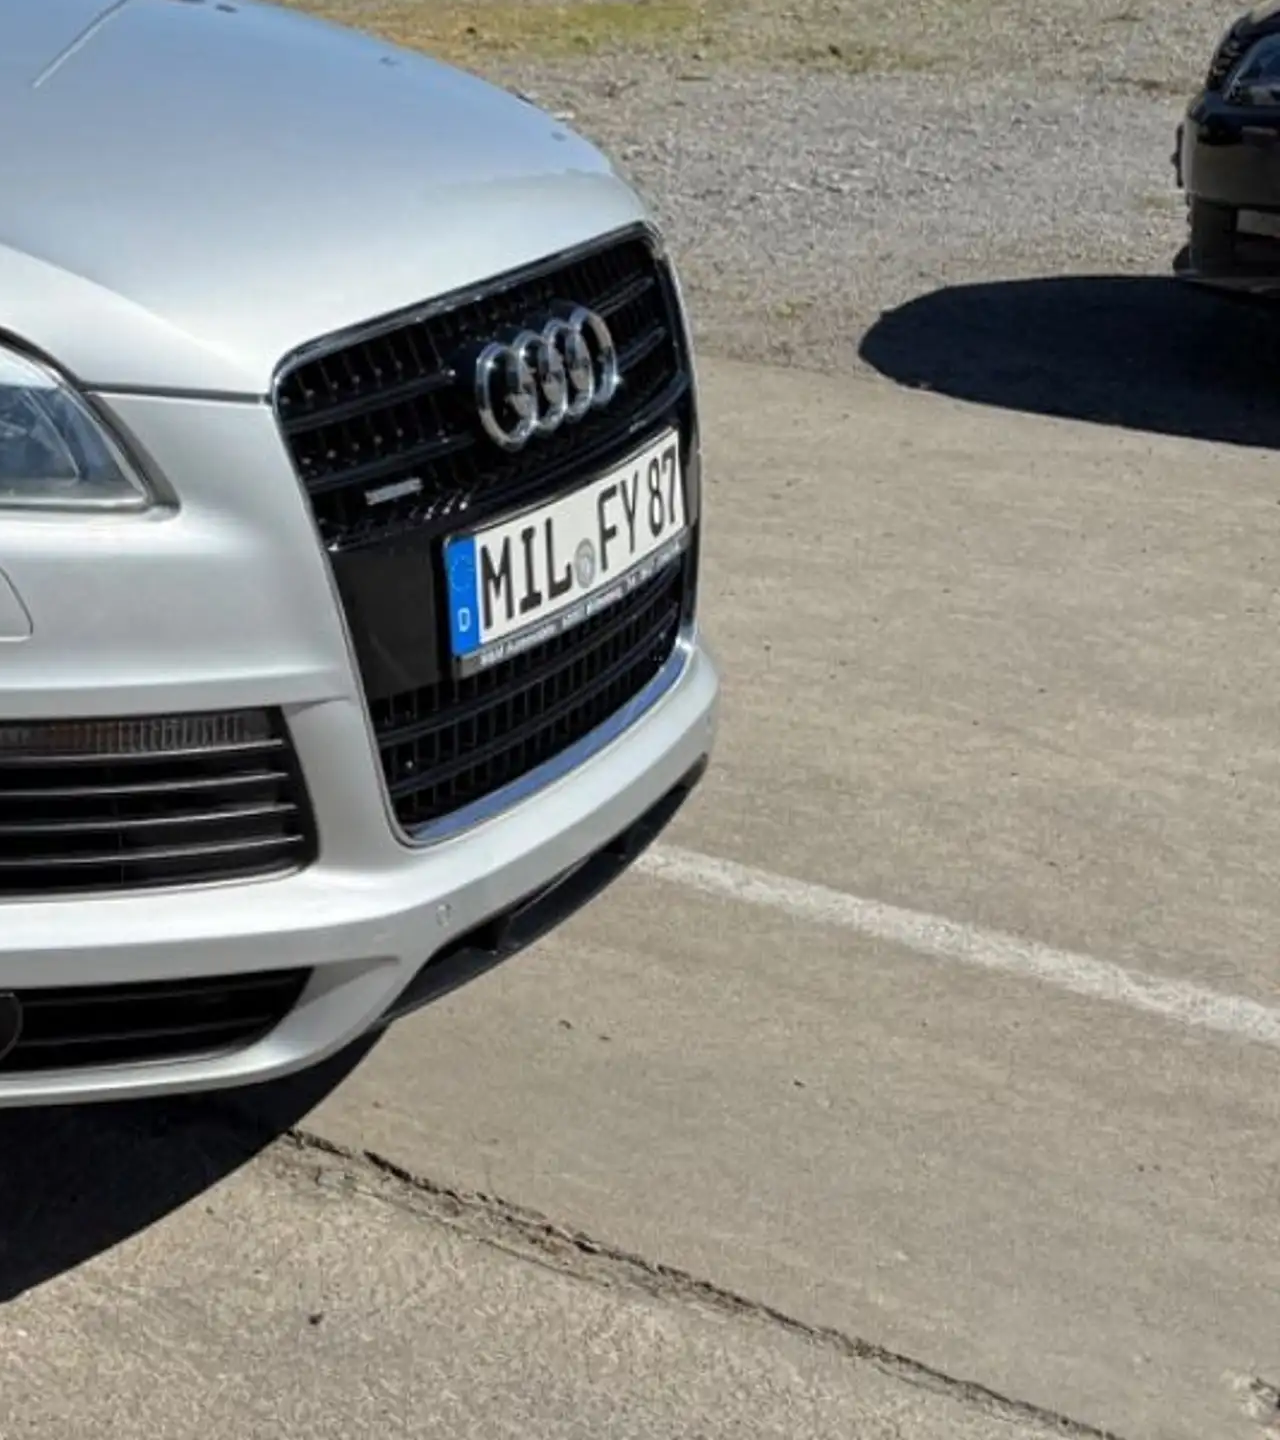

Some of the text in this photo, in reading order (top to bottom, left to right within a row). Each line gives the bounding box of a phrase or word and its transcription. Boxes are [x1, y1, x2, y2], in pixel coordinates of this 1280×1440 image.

[481, 517, 573, 630] MIL
[596, 469, 639, 572] FY
[648, 444, 677, 538] 87
[458, 607, 471, 633] D
